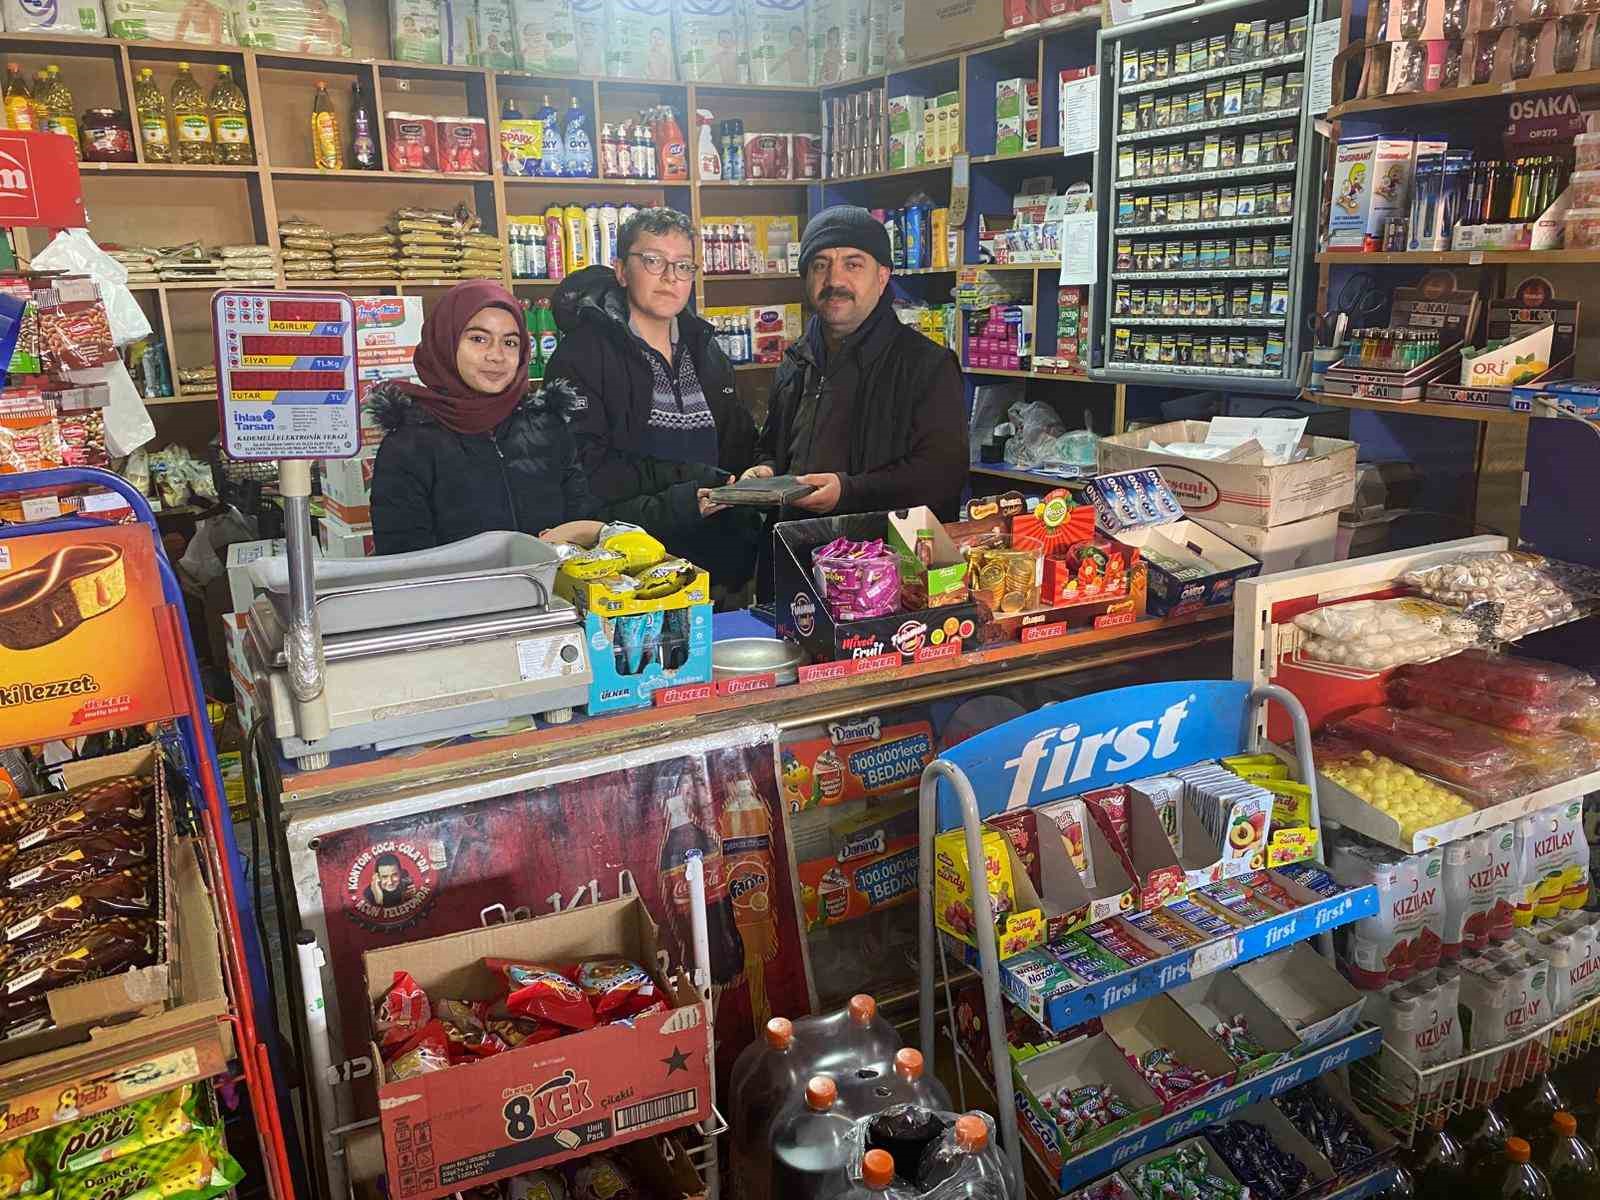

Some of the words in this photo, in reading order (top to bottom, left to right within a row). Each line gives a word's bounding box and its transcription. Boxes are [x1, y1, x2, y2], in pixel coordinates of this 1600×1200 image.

[1510, 95, 1577, 120] OSAKA
[570, 140, 587, 148] OXY
[232, 392, 261, 400] TUTAR
[1449, 390, 1489, 402] TOKAI
[235, 422, 274, 430] Tarsan
[1028, 626, 1064, 640] ÜLKER
[853, 642, 884, 659] Fruit
[920, 645, 956, 659] ÜLKER
[857, 657, 896, 672] ÜLKER
[24, 675, 98, 703] lezzet.
[600, 688, 631, 700] ÜLKER
[664, 688, 711, 703] ÜLKER
[728, 679, 769, 693] ÜLKER
[833, 723, 875, 741] Danino
[1004, 696, 1190, 809] first
[841, 837, 880, 857] Danino
[1534, 831, 1575, 858] KIZILAY
[729, 873, 768, 899] Fanta
[874, 873, 919, 898] BEDAV
[1315, 902, 1345, 928] first
[1265, 918, 1296, 948] first
[1028, 965, 1056, 984] Nazar
[1158, 961, 1191, 989] firs
[1568, 955, 1600, 986] KIZILA
[1102, 979, 1138, 1010] first
[1318, 1048, 1350, 1074] first
[1270, 1068, 1302, 1094] first
[599, 1086, 635, 1109] Çilekli
[586, 1121, 604, 1133] Unit
[1015, 1092, 1061, 1153] Nazar
[56, 1111, 136, 1172] pöti
[586, 1131, 606, 1142] Pack
[1112, 1136, 1147, 1165] first
[84, 1164, 139, 1189] Dankek
